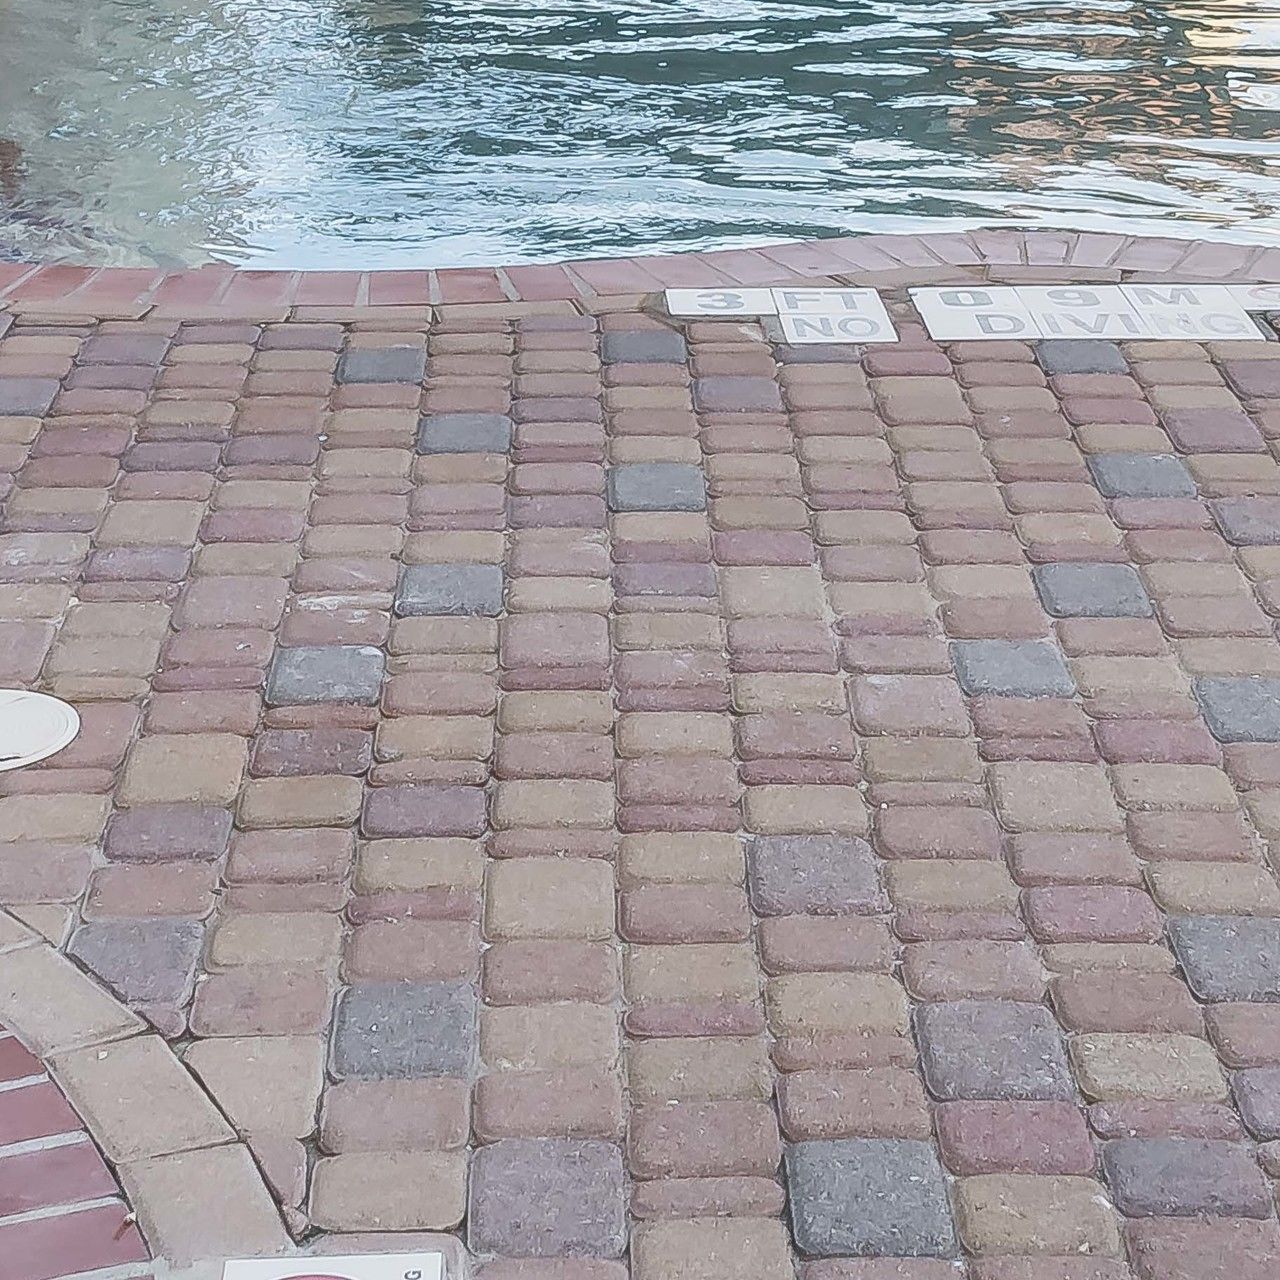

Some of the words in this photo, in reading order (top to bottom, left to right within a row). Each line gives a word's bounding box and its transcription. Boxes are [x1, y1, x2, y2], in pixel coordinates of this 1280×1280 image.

[696, 292, 745, 310] 3
[785, 291, 868, 310] FT
[1132, 286, 1203, 306] M
[793, 316, 883, 338] NO
[974, 312, 1251, 336] DIVING
